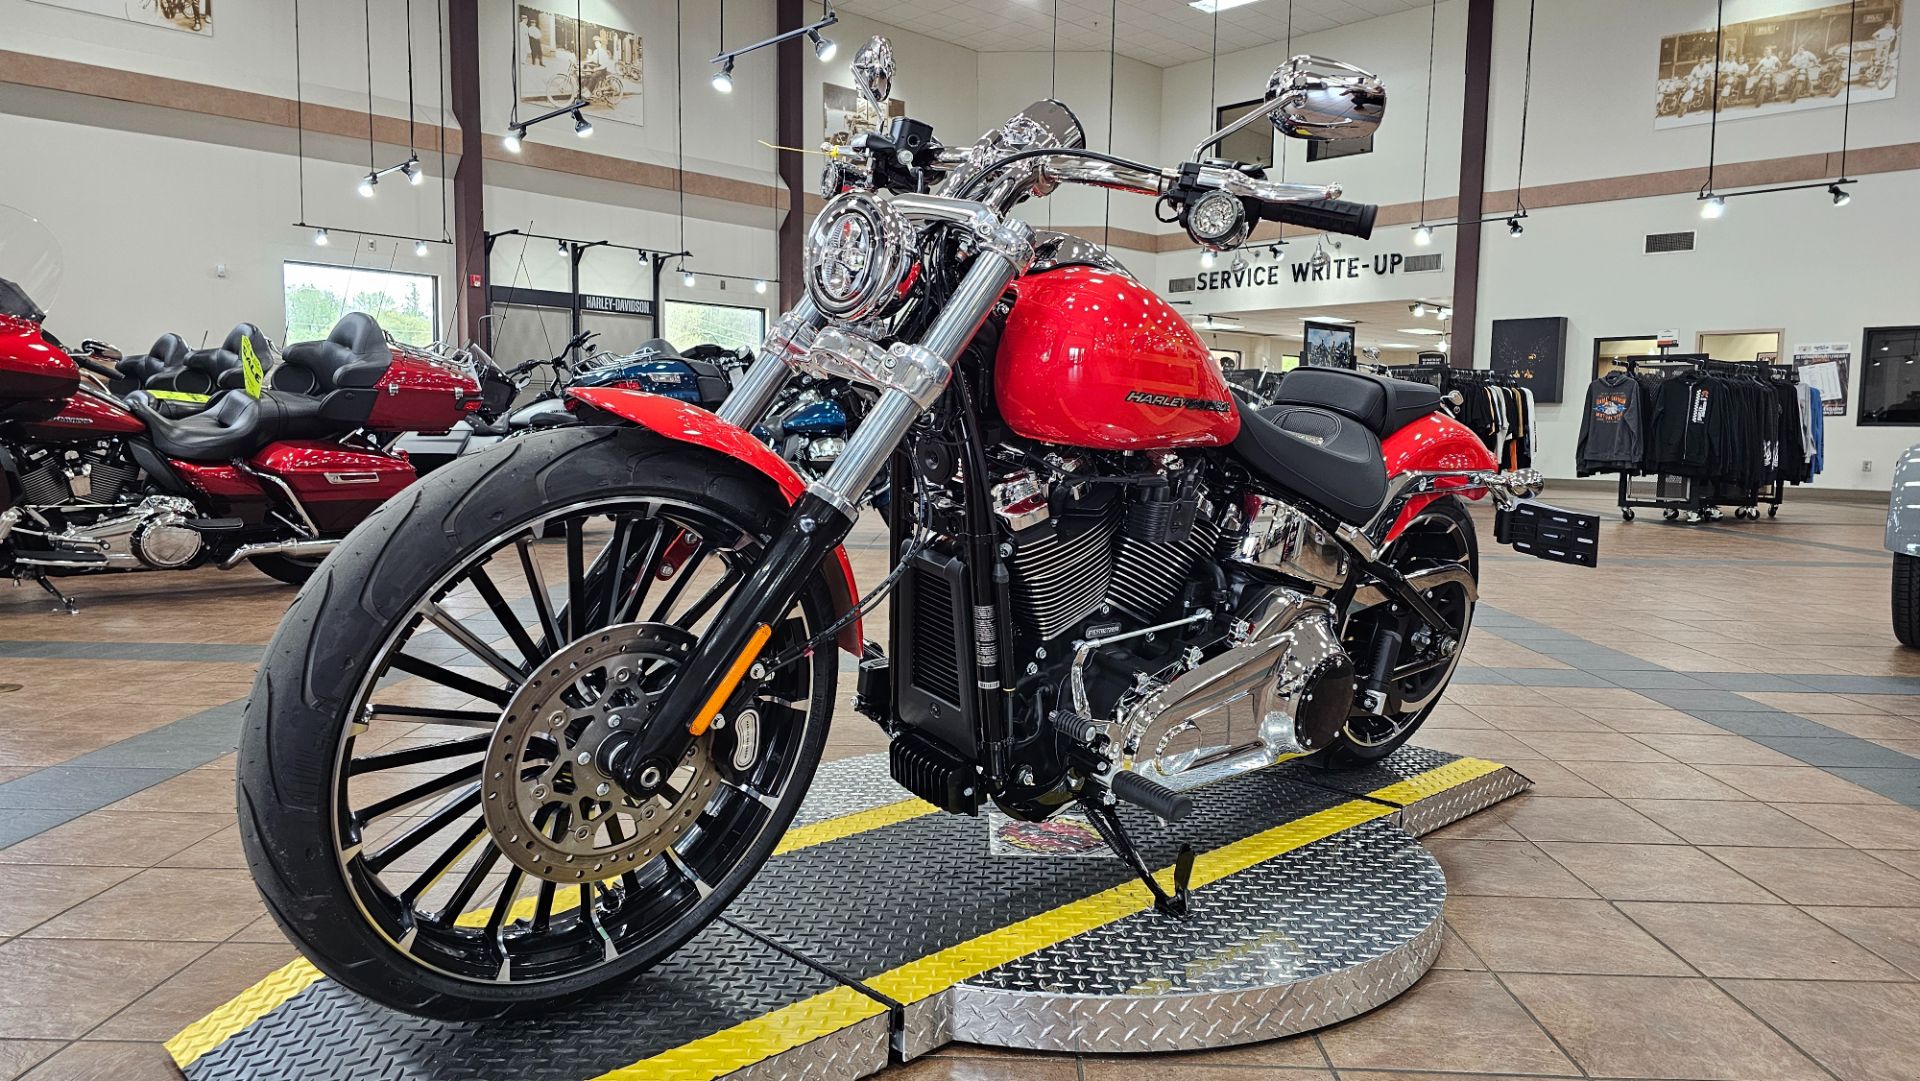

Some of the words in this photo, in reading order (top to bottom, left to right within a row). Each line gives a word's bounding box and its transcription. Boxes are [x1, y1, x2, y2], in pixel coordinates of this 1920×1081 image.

[1196, 265, 1279, 291] SERVICE
[1291, 253, 1404, 283] WRITE-UP
[586, 296, 650, 314] HARLEY-DAVIDSON
[1126, 391, 1231, 412] HARLEY-SON
